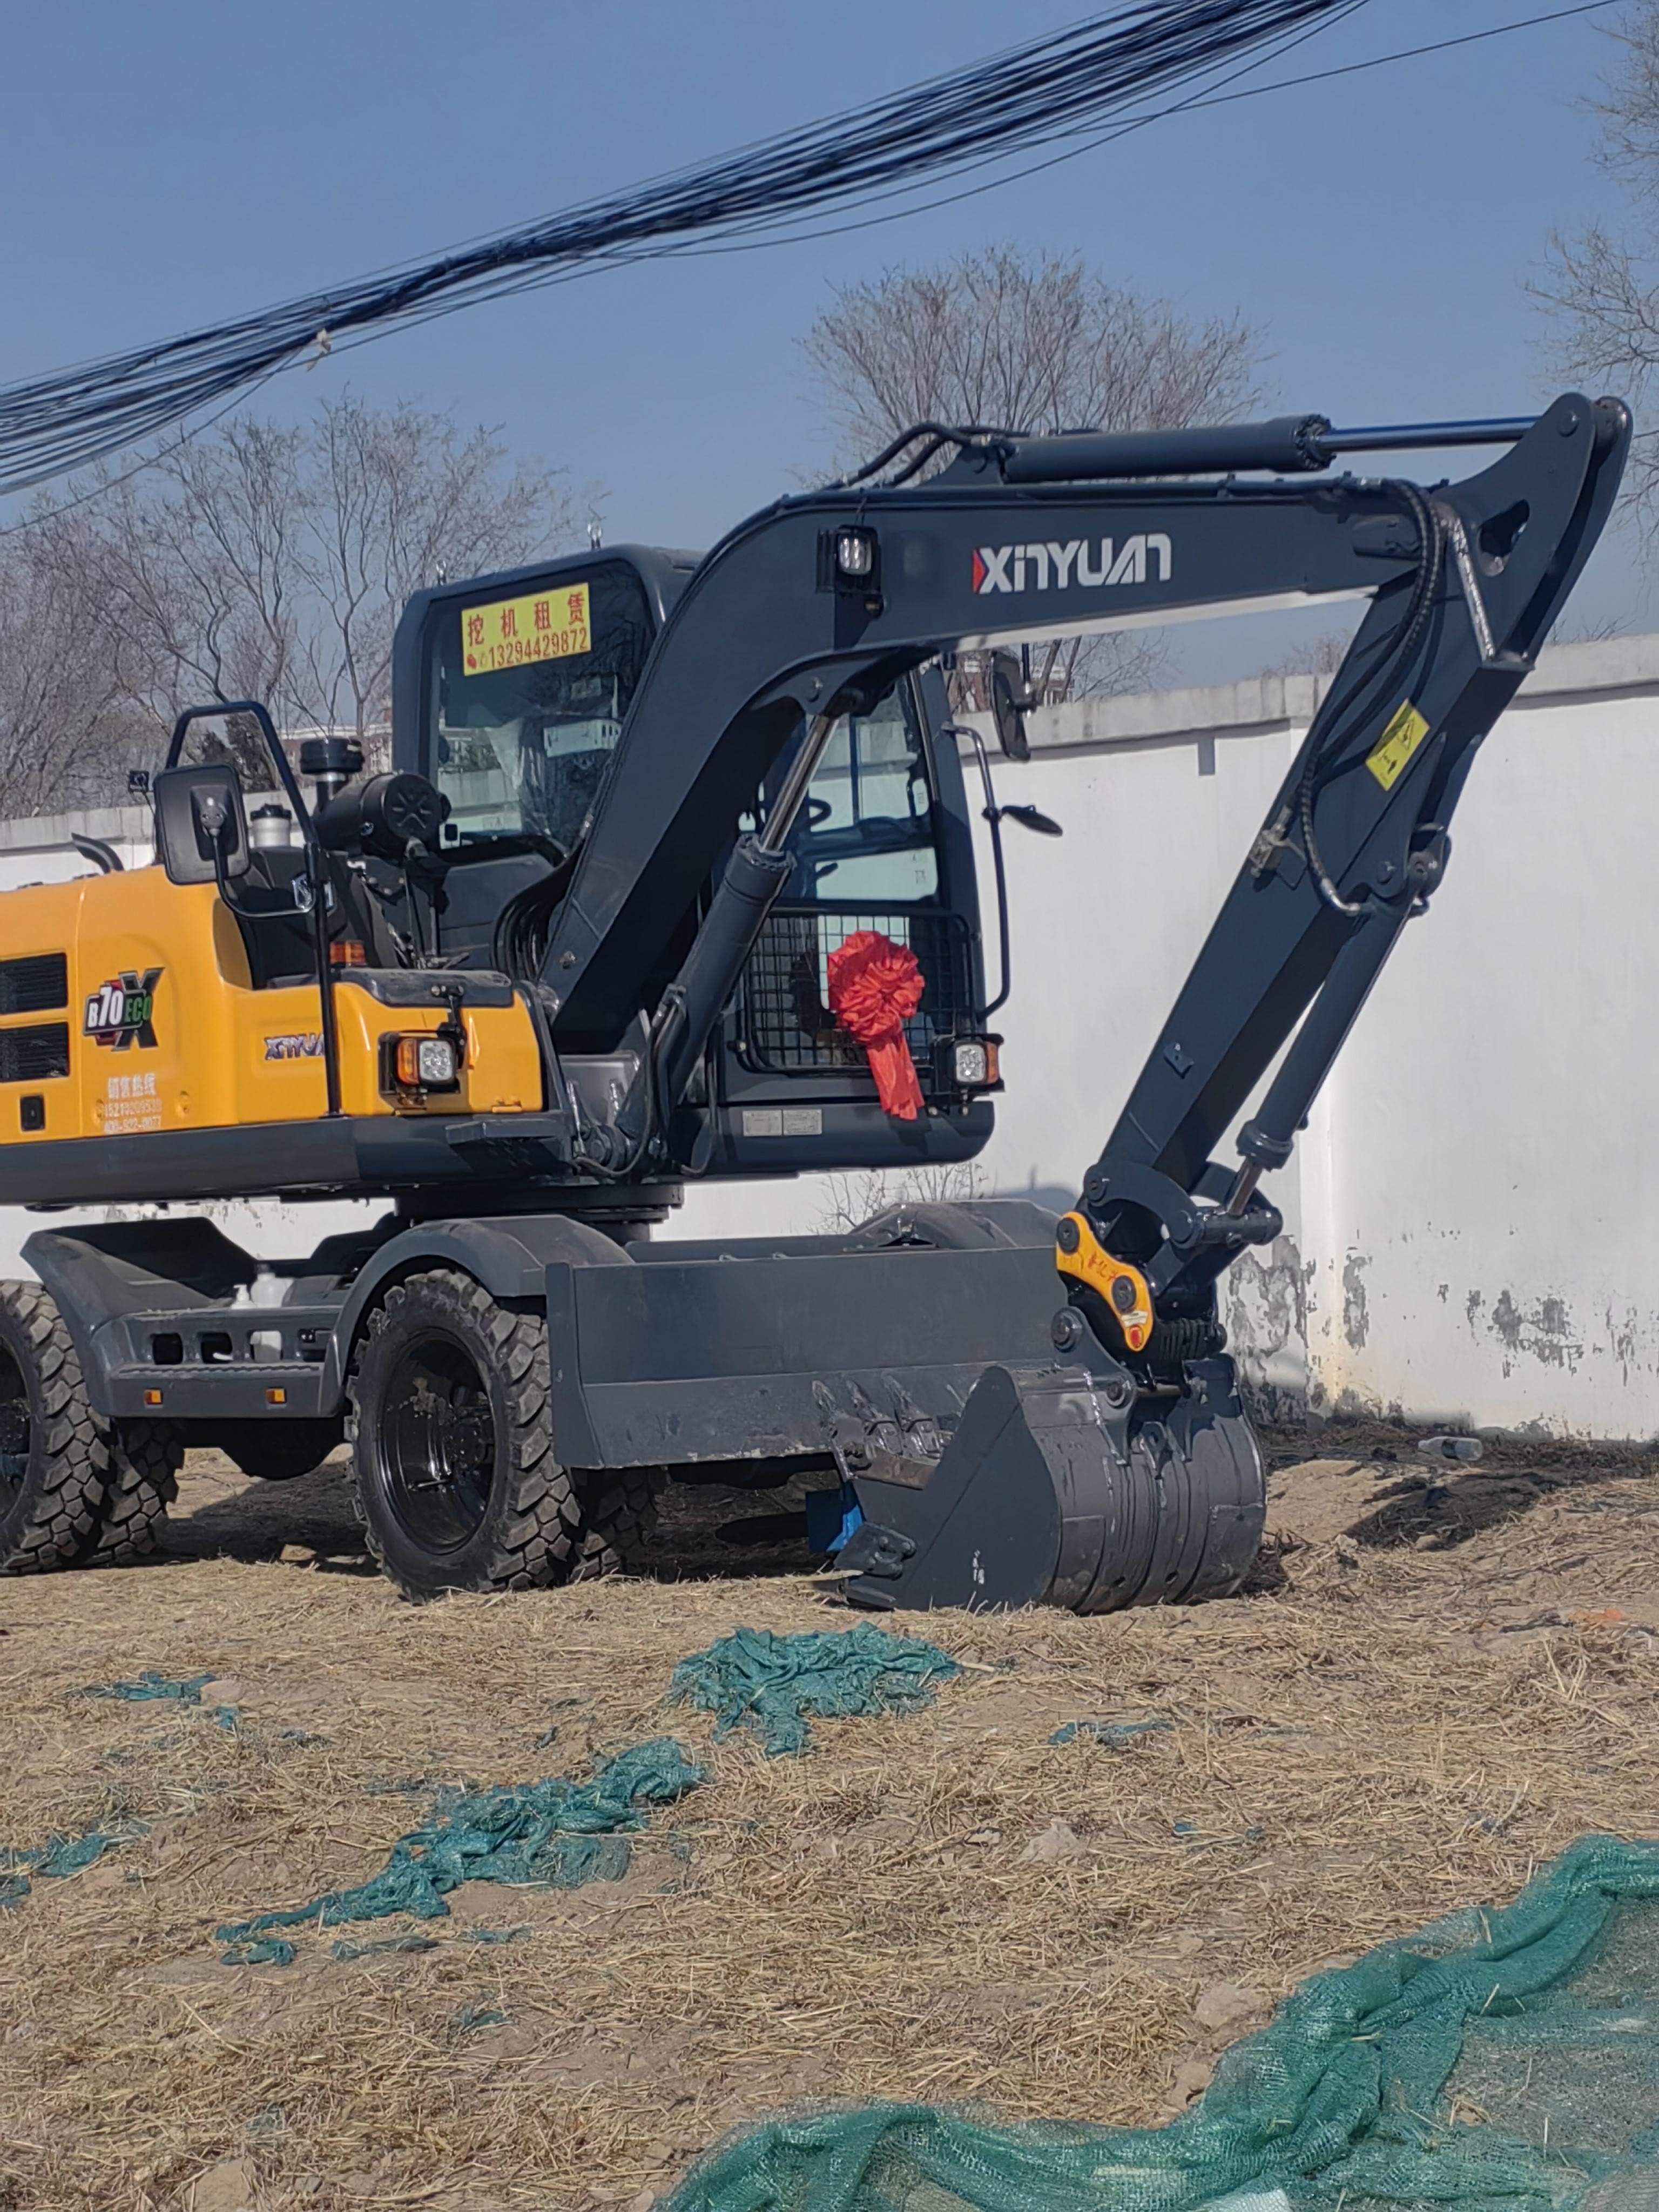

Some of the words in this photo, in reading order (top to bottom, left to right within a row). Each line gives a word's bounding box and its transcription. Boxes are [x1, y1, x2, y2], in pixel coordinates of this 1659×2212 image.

[468, 592, 584, 646] 挖机租赁
[489, 626, 588, 669] 13294429872
[87, 986, 124, 1028] B70
[124, 996, 152, 1022] ECO
